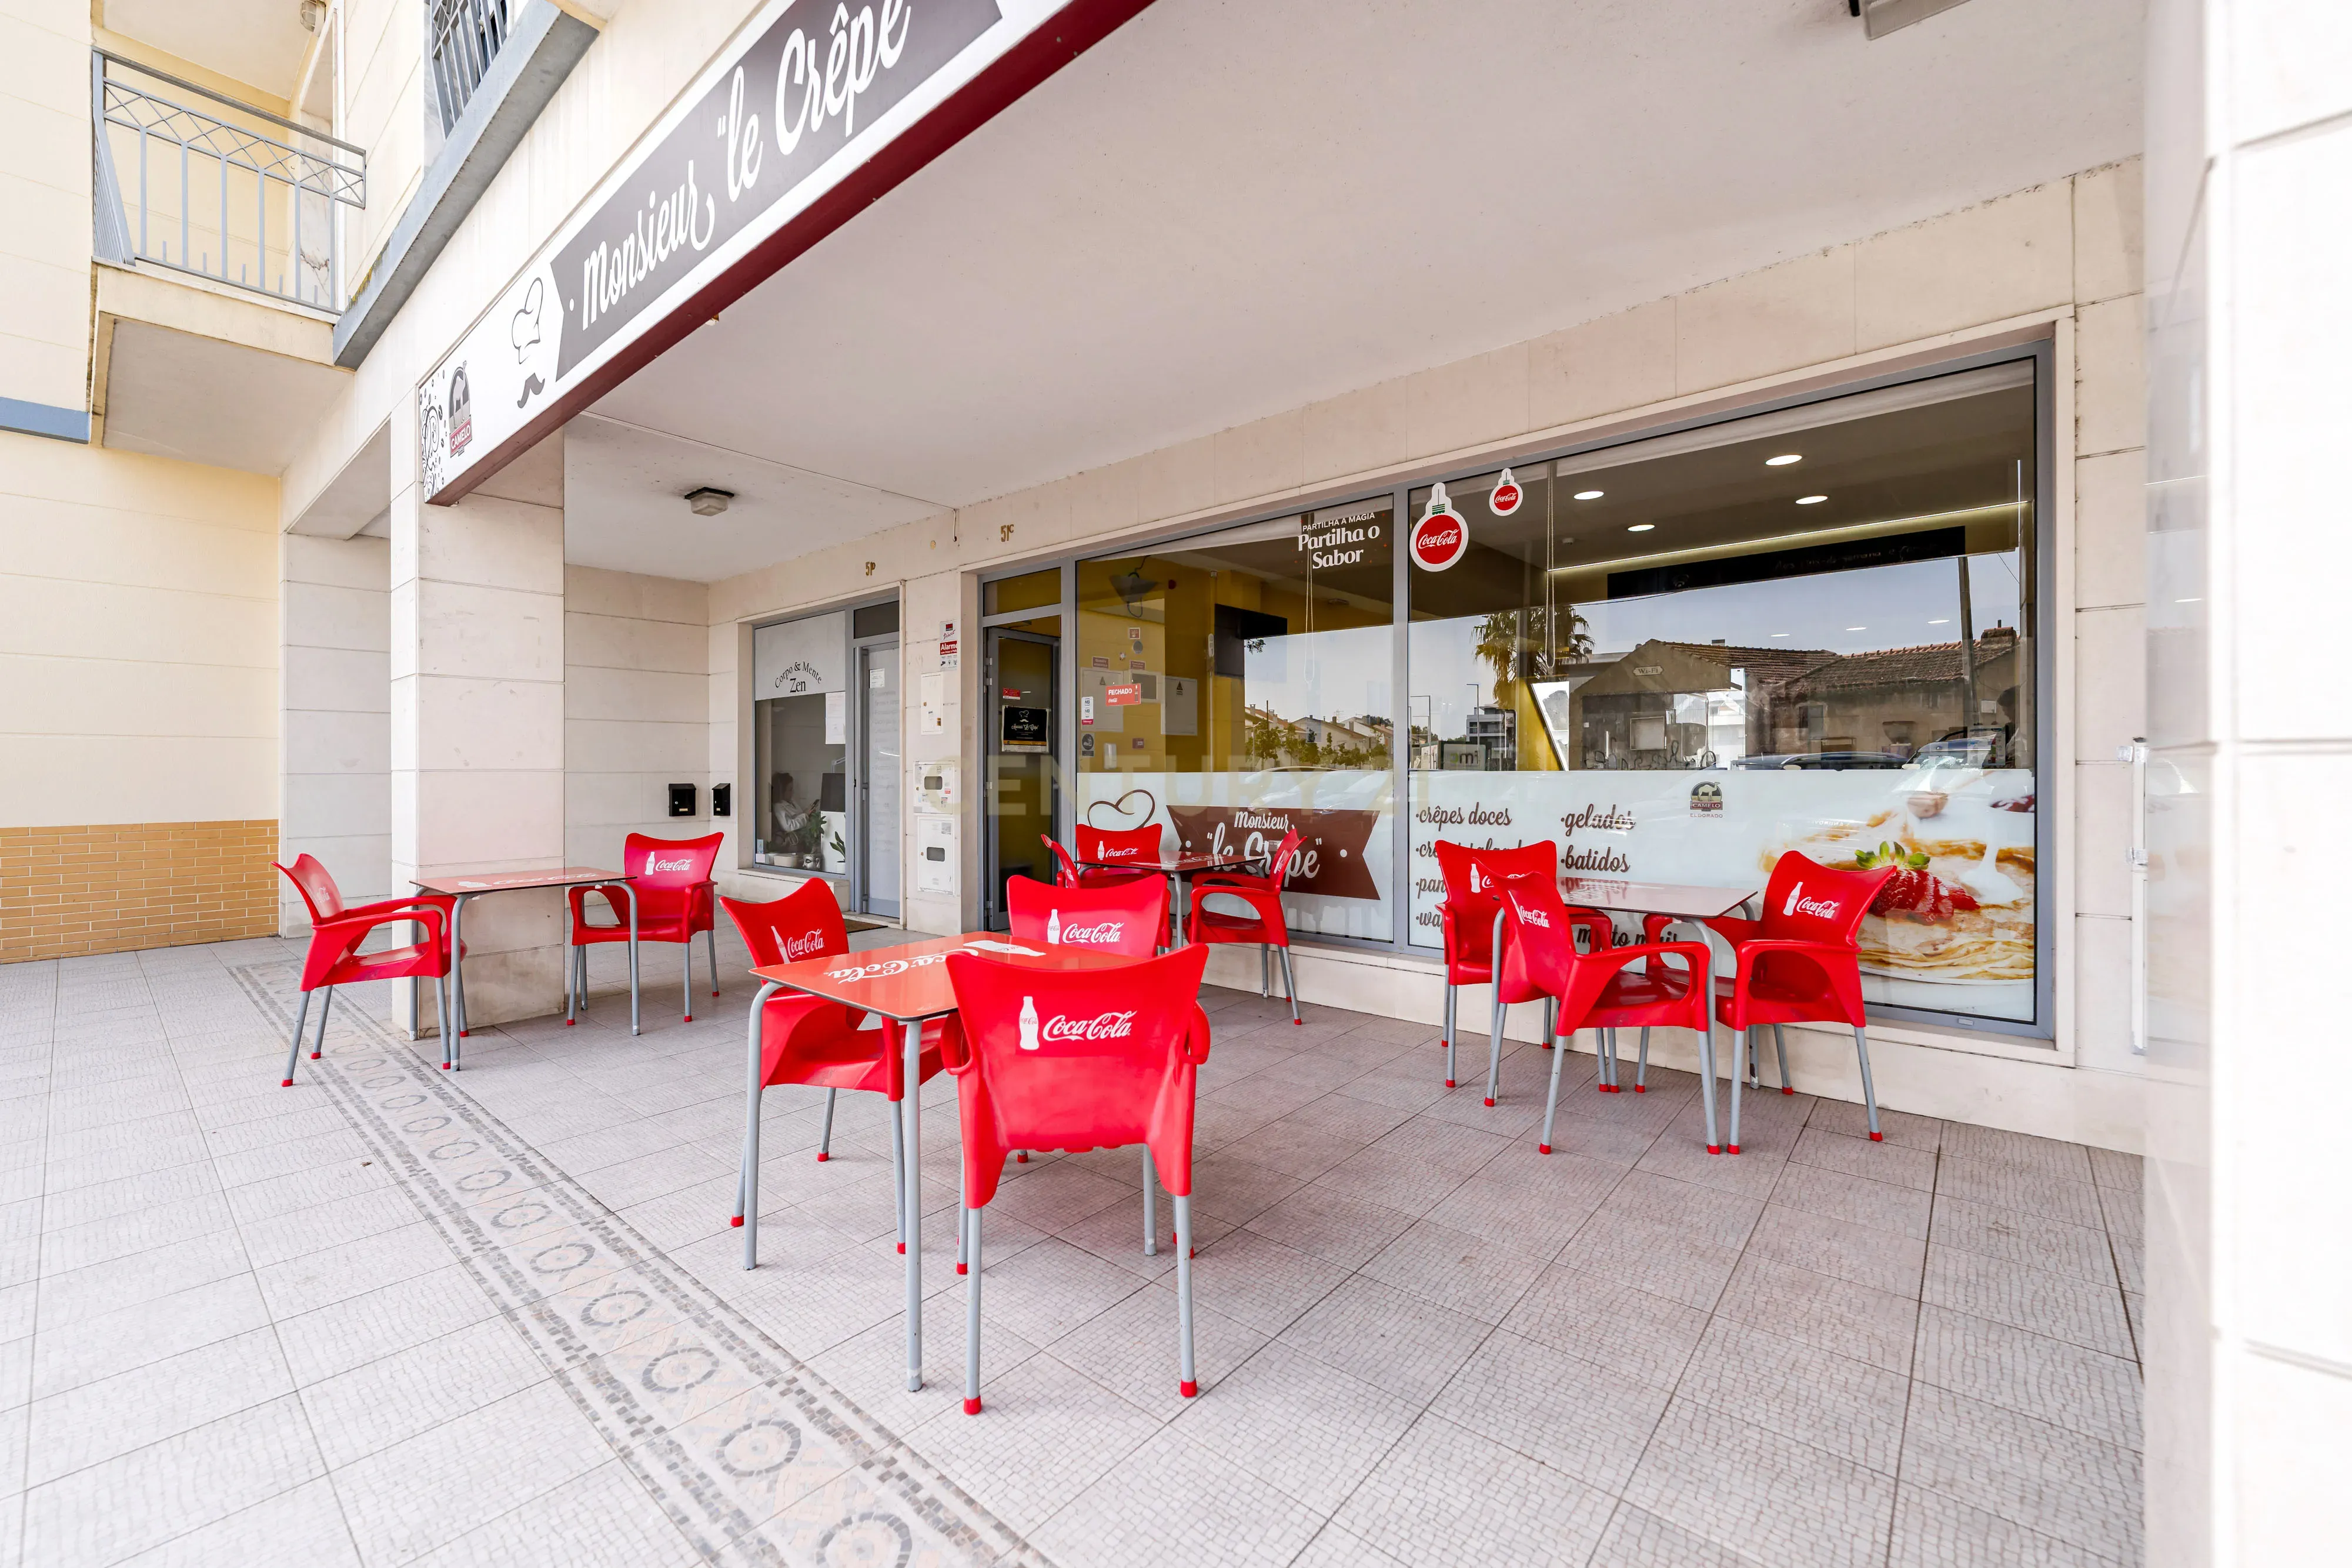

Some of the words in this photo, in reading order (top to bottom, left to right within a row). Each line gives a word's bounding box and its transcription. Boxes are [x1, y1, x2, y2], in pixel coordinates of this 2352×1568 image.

[582, 160, 715, 331] Monsieur
[451, 424, 470, 450] CAMELO
[1495, 492, 1518, 503] Coca-Cola
[1302, 519, 1339, 532] PARTILHA
[1349, 512, 1375, 524] MAGIA
[1298, 528, 1365, 551] Partilha
[1368, 526, 1380, 539] o
[1418, 529, 1461, 549] Coca-Cola
[1312, 549, 1364, 570] Sabor
[775, 667, 793, 688] Corpo
[794, 661, 801, 671] &
[803, 661, 822, 684] Mente
[790, 678, 806, 693] Zen
[1234, 811, 1295, 834] Monsieur
[1419, 805, 1465, 831] crêpes
[1468, 802, 1512, 826] doces
[1565, 803, 1636, 837] gelados
[655, 859, 693, 871] Coca-Cola
[1565, 845, 1631, 872] batidos
[1519, 905, 1550, 928] Coca-Cola
[1796, 897, 1840, 919] Coca-Cola
[787, 928, 824, 958] Coca-Cola
[1063, 922, 1125, 944] Coca-Cola
[1043, 1010, 1138, 1042] Coca-Cola
